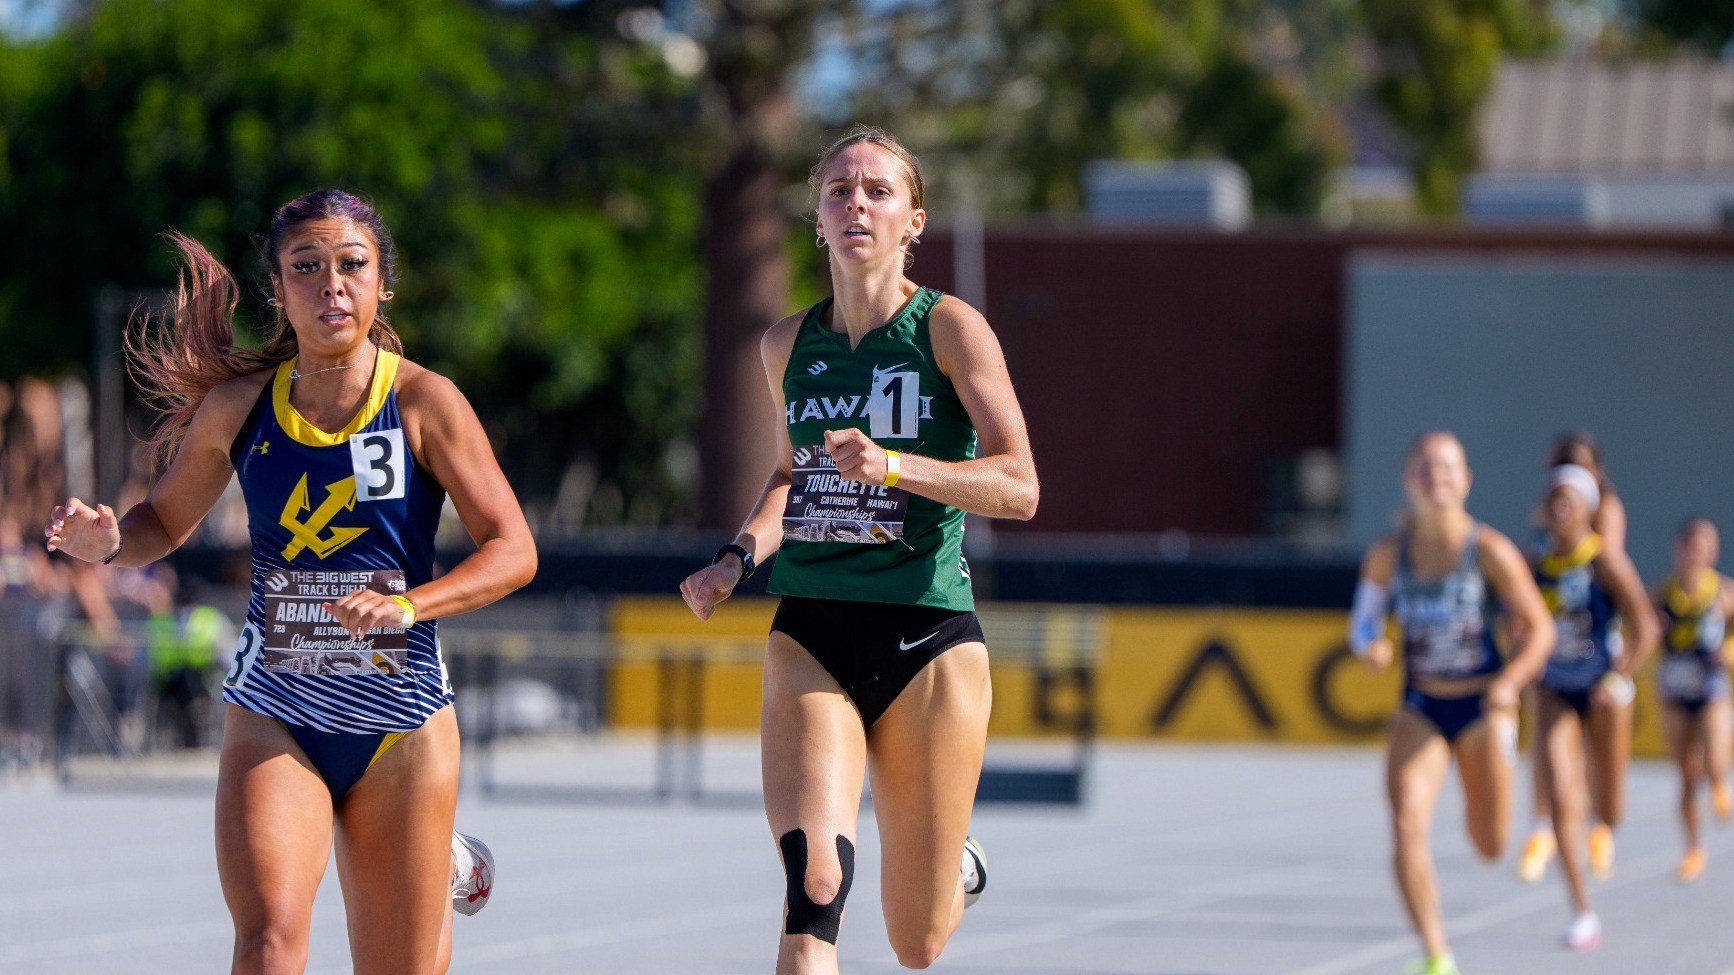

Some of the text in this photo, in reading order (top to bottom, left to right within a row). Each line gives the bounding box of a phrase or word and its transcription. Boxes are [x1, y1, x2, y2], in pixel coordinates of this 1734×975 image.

[882, 376, 903, 435] 1
[362, 435, 395, 497] 3
[818, 457, 837, 467] TRAC
[820, 496, 859, 507] CATHERINE
[804, 503, 875, 521] Championships
[290, 571, 314, 583] THE
[339, 571, 375, 583] WEST
[297, 584, 329, 596] TRACK
[330, 584, 338, 596] &
[275, 602, 340, 623] ABAND
[273, 624, 286, 633] 723
[313, 626, 350, 636] ALLYSON
[383, 626, 406, 635] DIEGO
[290, 633, 375, 651] Championships
[226, 627, 254, 687] 3
